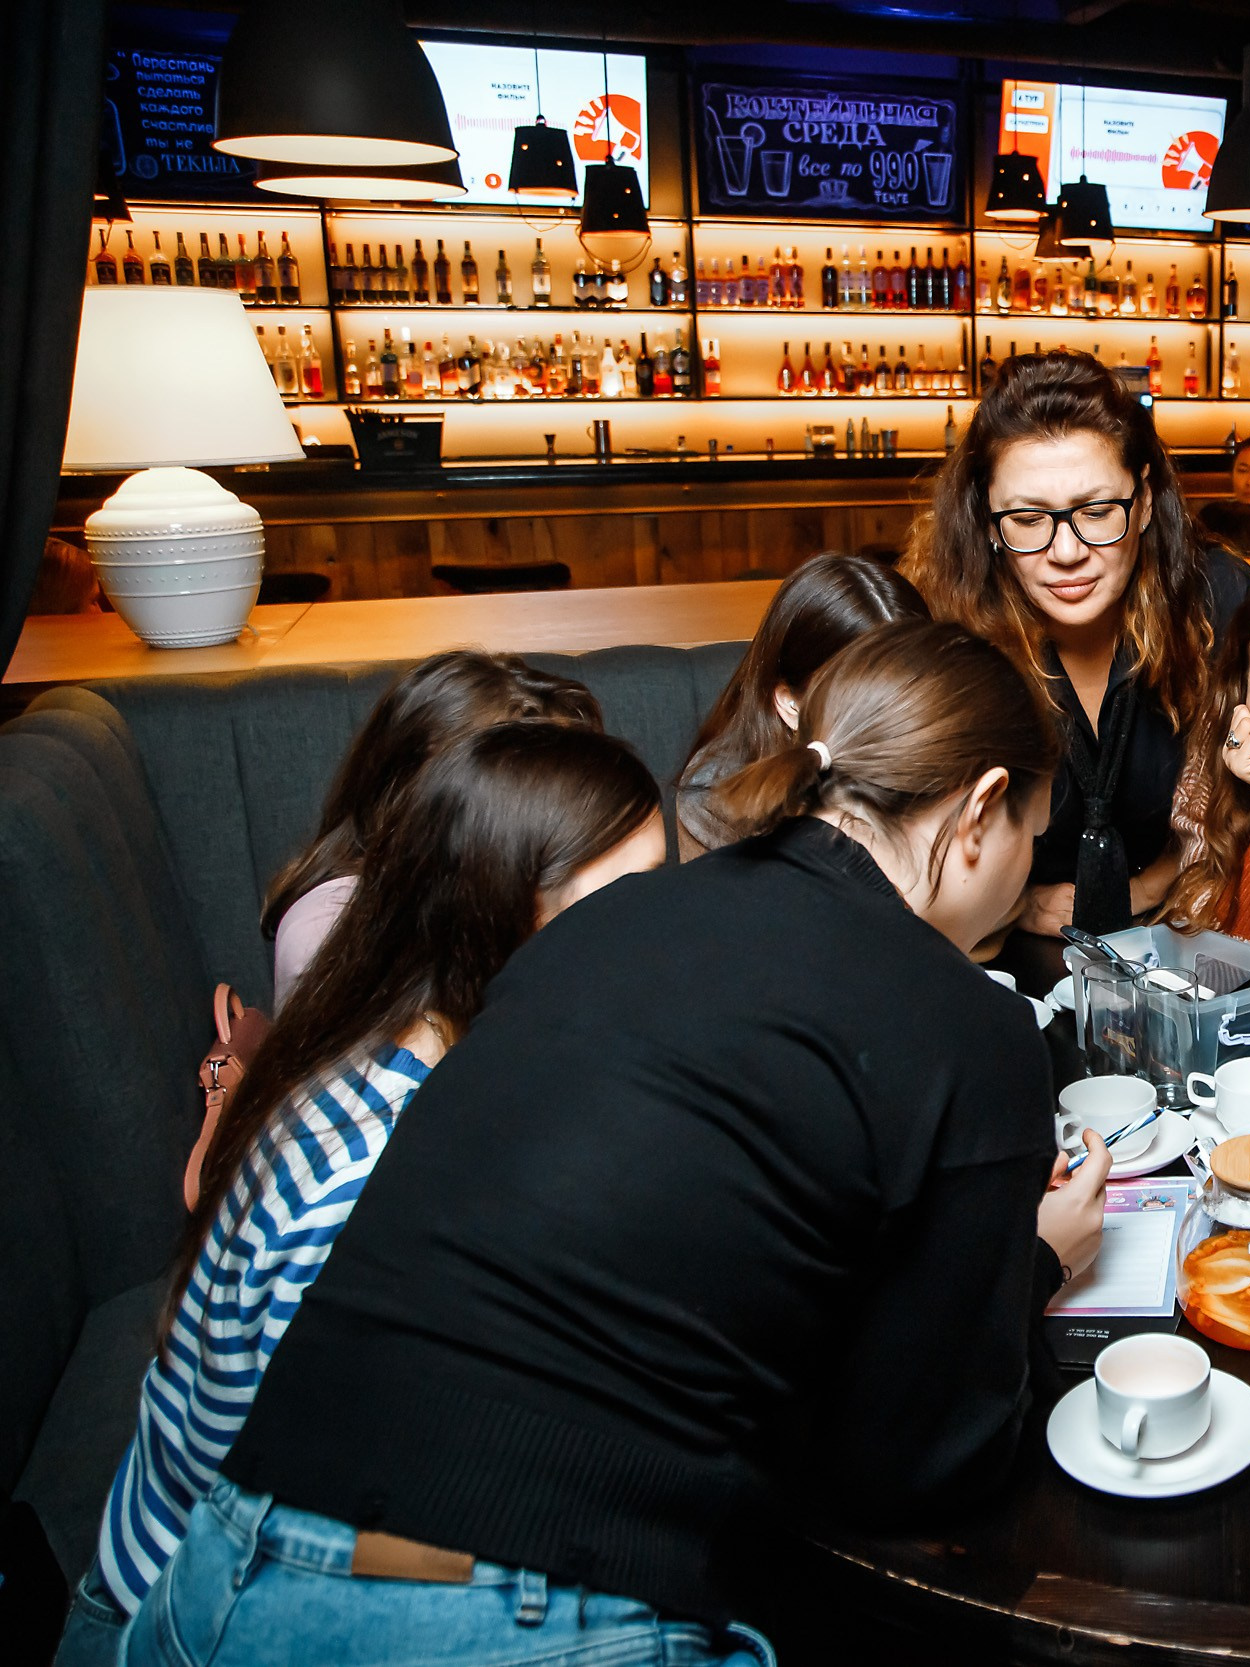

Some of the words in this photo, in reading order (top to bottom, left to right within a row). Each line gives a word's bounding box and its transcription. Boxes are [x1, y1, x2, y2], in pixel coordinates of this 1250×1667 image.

[136, 71, 205, 85] пытаться
[140, 102, 203, 116] каждого
[726, 93, 938, 127] КОКТЕЙЛЬНАЯ
[146, 136, 169, 148] ты
[176, 138, 193, 150] не
[783, 121, 887, 150] СРЕДА
[160, 153, 241, 174] ТЕКИЛА
[799, 154, 830, 177] все
[840, 163, 862, 177] по
[869, 151, 919, 191] 990
